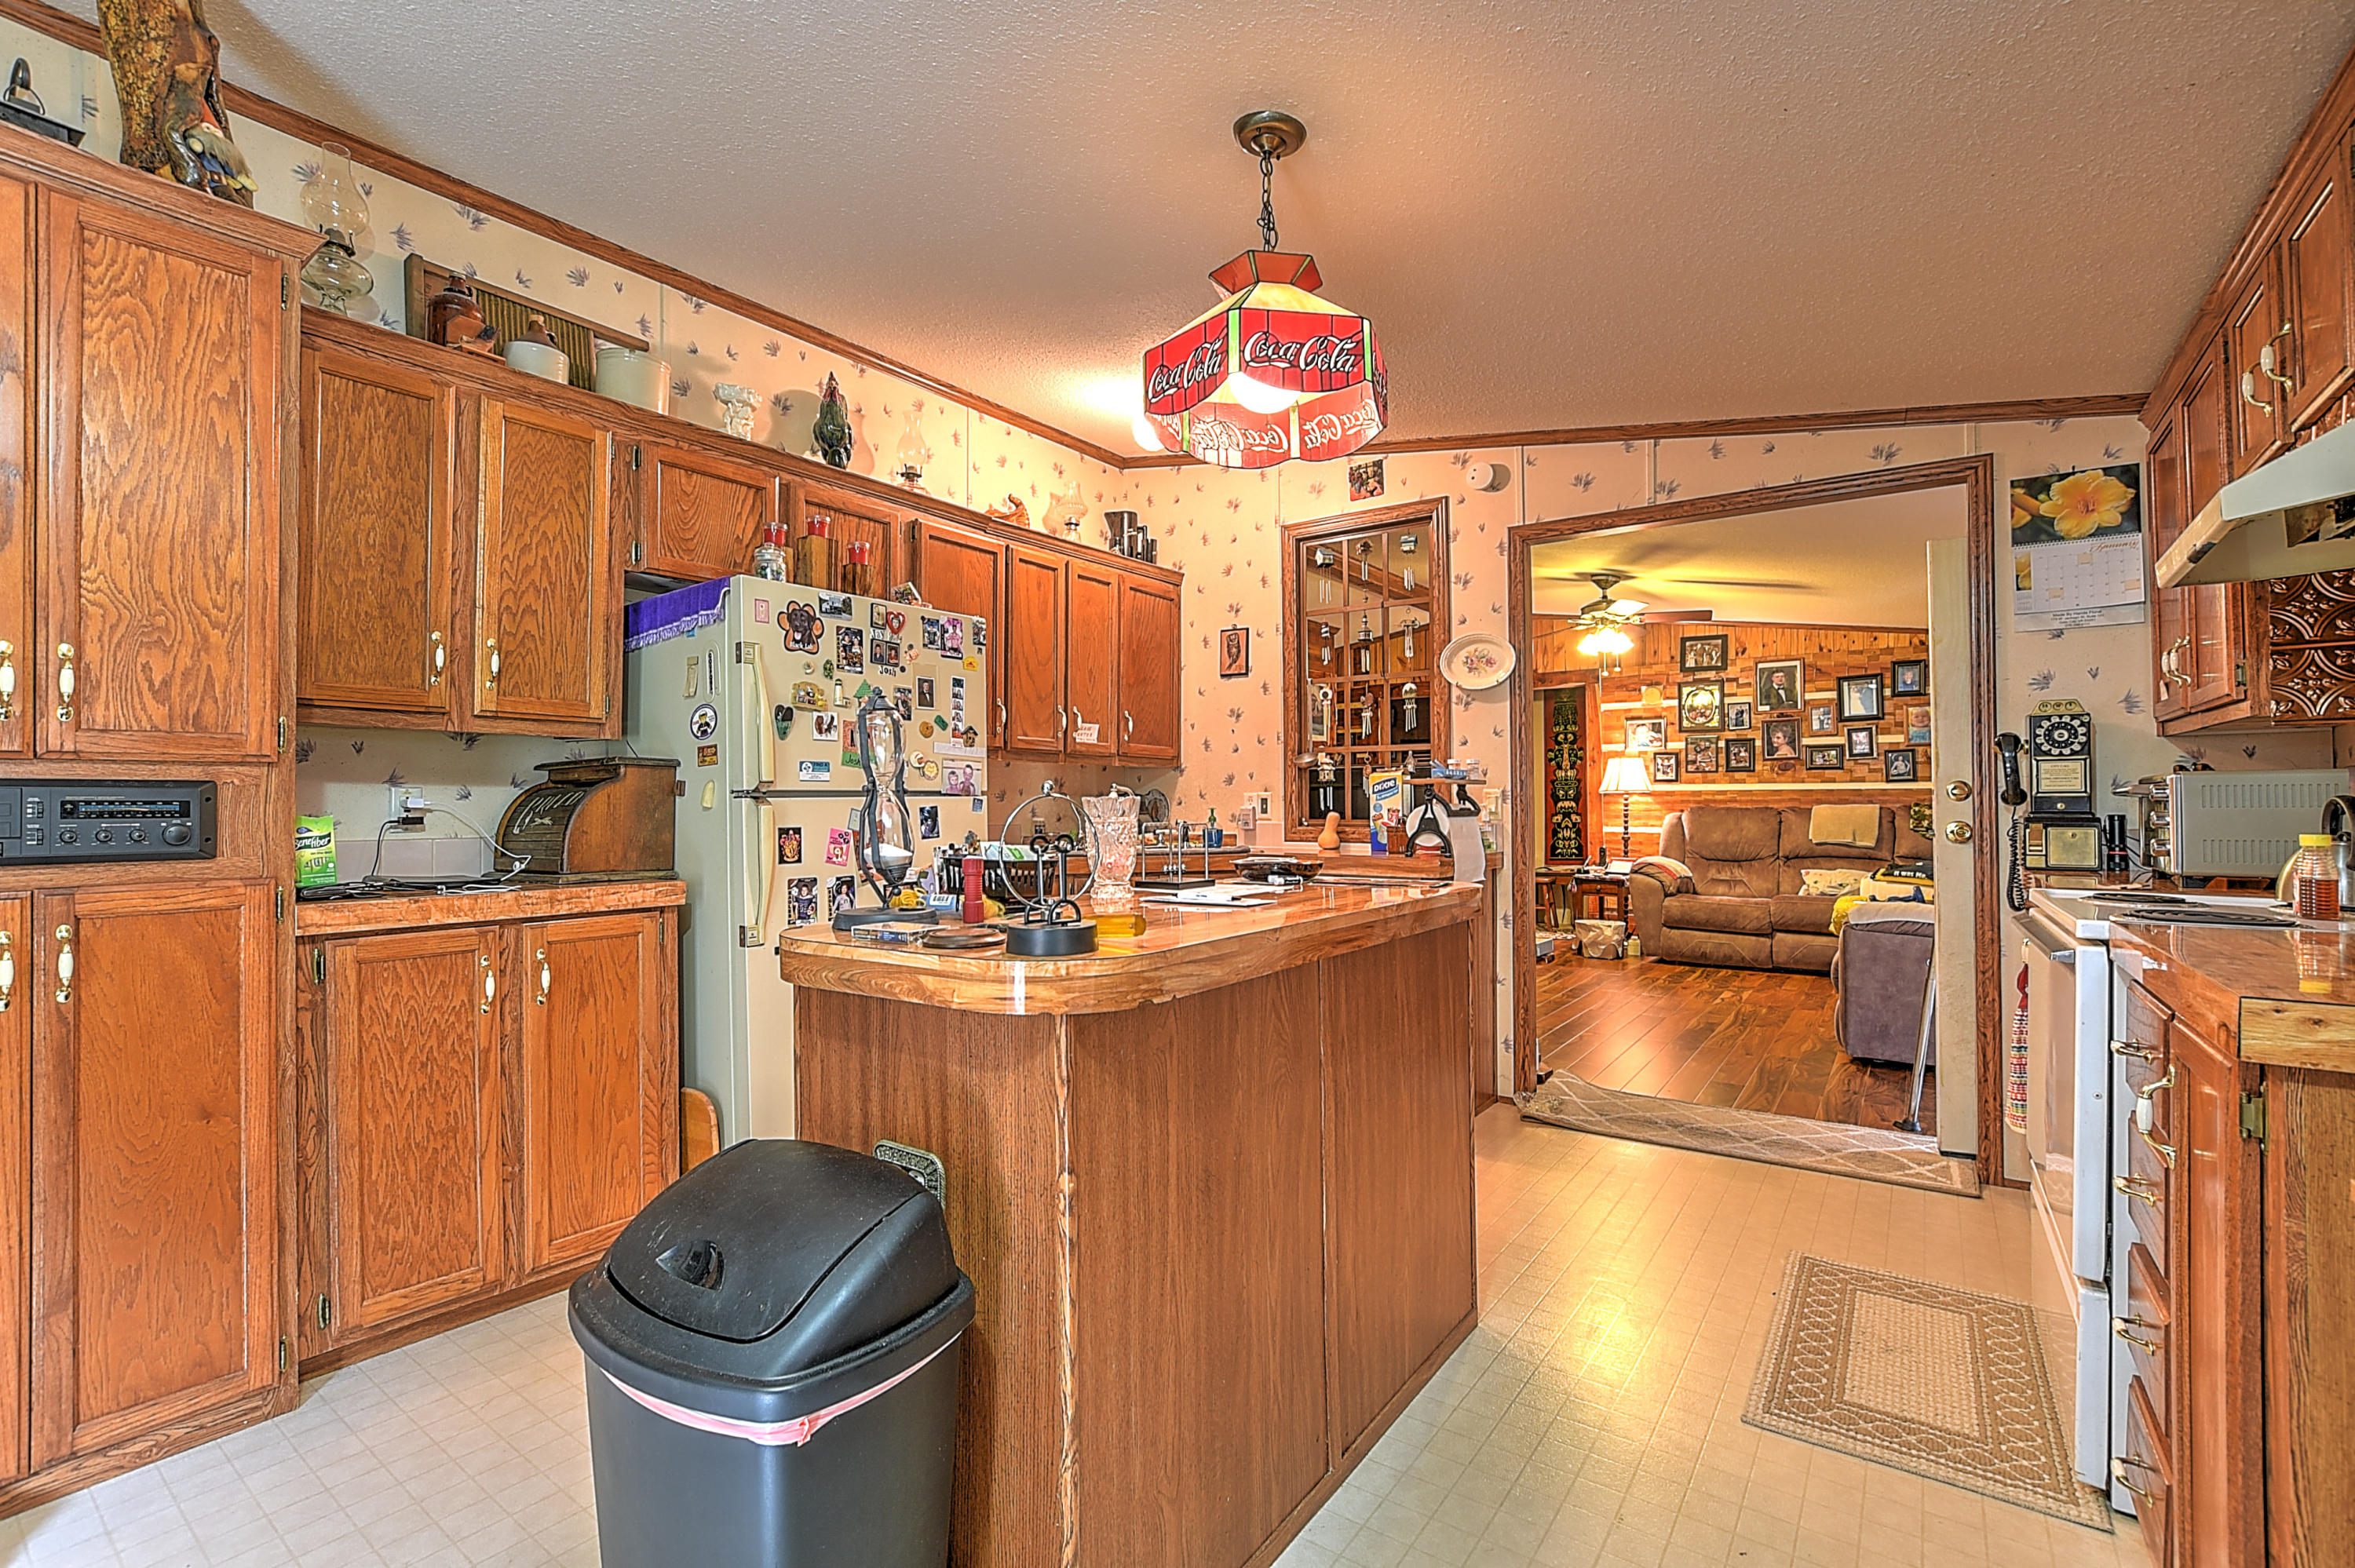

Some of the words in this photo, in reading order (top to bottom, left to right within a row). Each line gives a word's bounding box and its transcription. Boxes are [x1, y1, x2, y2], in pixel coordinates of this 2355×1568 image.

[1243, 331, 1300, 367] Coca
[1299, 335, 1357, 372] Cola
[1148, 363, 1184, 403] Coca
[1184, 337, 1223, 389] Cola
[790, 641, 804, 650] Black
[879, 665, 896, 677] Josh
[845, 753, 861, 765] Josh
